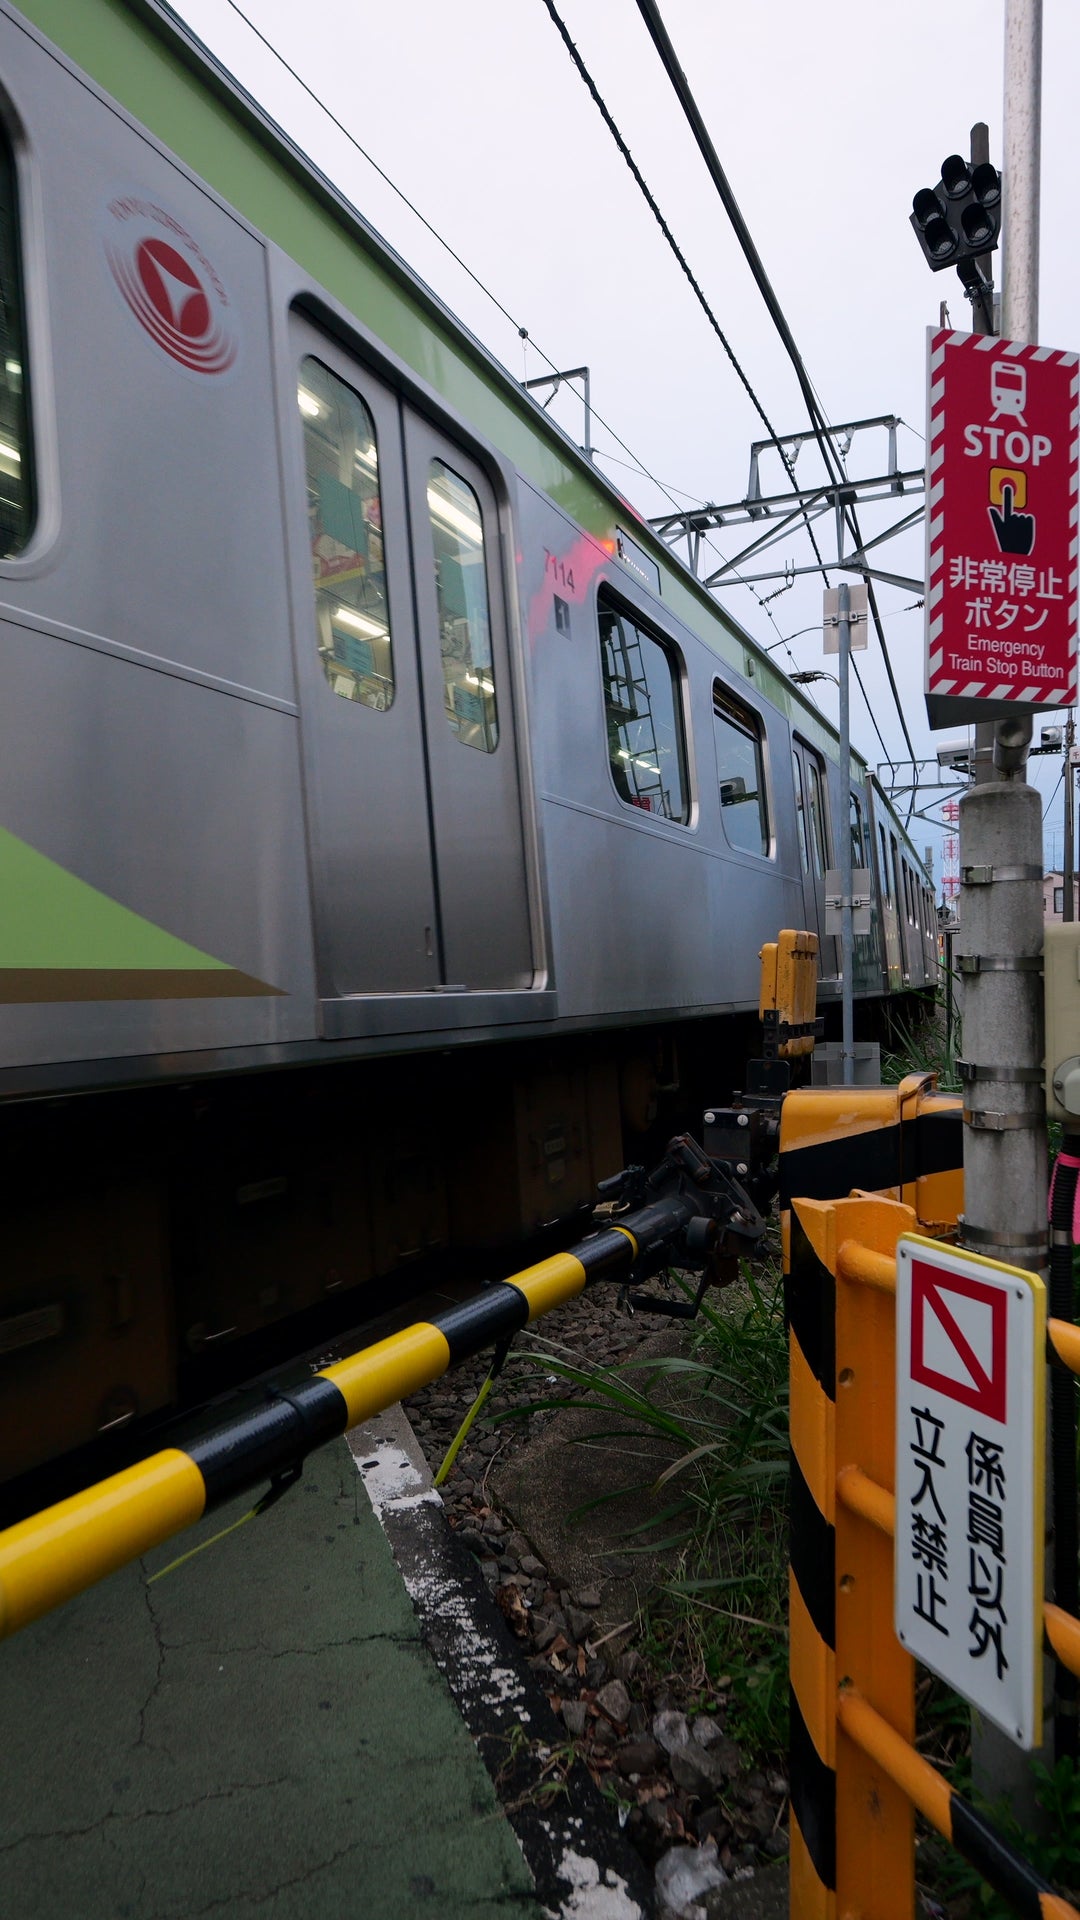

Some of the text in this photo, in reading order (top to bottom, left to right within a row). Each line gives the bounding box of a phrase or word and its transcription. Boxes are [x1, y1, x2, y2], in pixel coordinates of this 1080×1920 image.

[963, 423, 1052, 466] STOP
[543, 546, 575, 593] 7114
[950, 556, 1064, 600] 非常停止
[964, 596, 1049, 632] ボタン
[949, 653, 1064, 679] Train Stop Button
[967, 634, 1045, 660] Emergency
[910, 1406, 950, 1637] 立入禁止
[965, 1431, 1009, 1681] 係員以外
